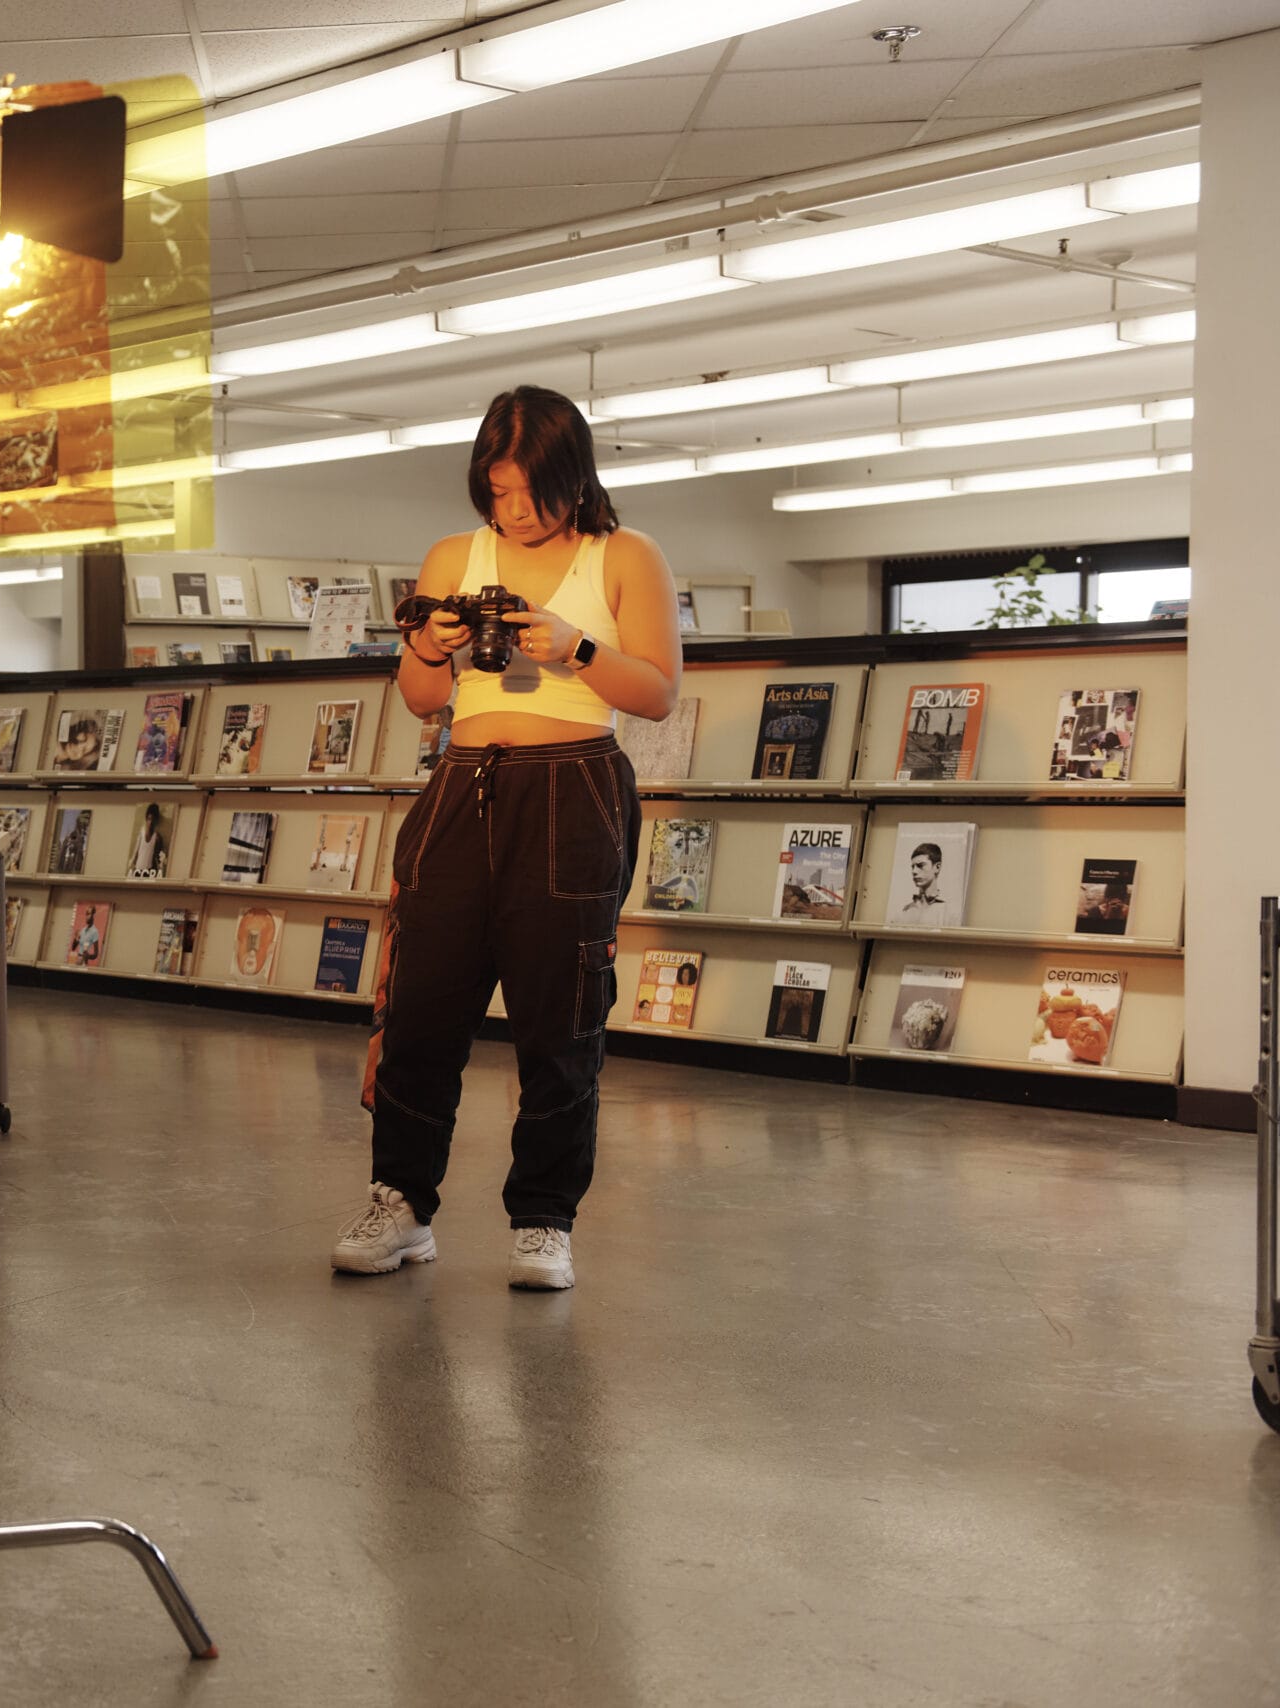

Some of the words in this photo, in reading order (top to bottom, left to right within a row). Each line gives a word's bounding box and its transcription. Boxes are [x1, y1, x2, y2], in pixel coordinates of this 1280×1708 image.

[767, 688, 791, 702] Arts
[792, 687, 803, 701] of
[804, 687, 829, 700] Asia
[911, 688, 980, 708] BOMB
[789, 829, 843, 848] AZURE
[646, 951, 698, 965] BELIEVER
[943, 969, 962, 980] 120
[1047, 969, 1119, 984] ceramics
[783, 979, 811, 988] SCHOLAR
